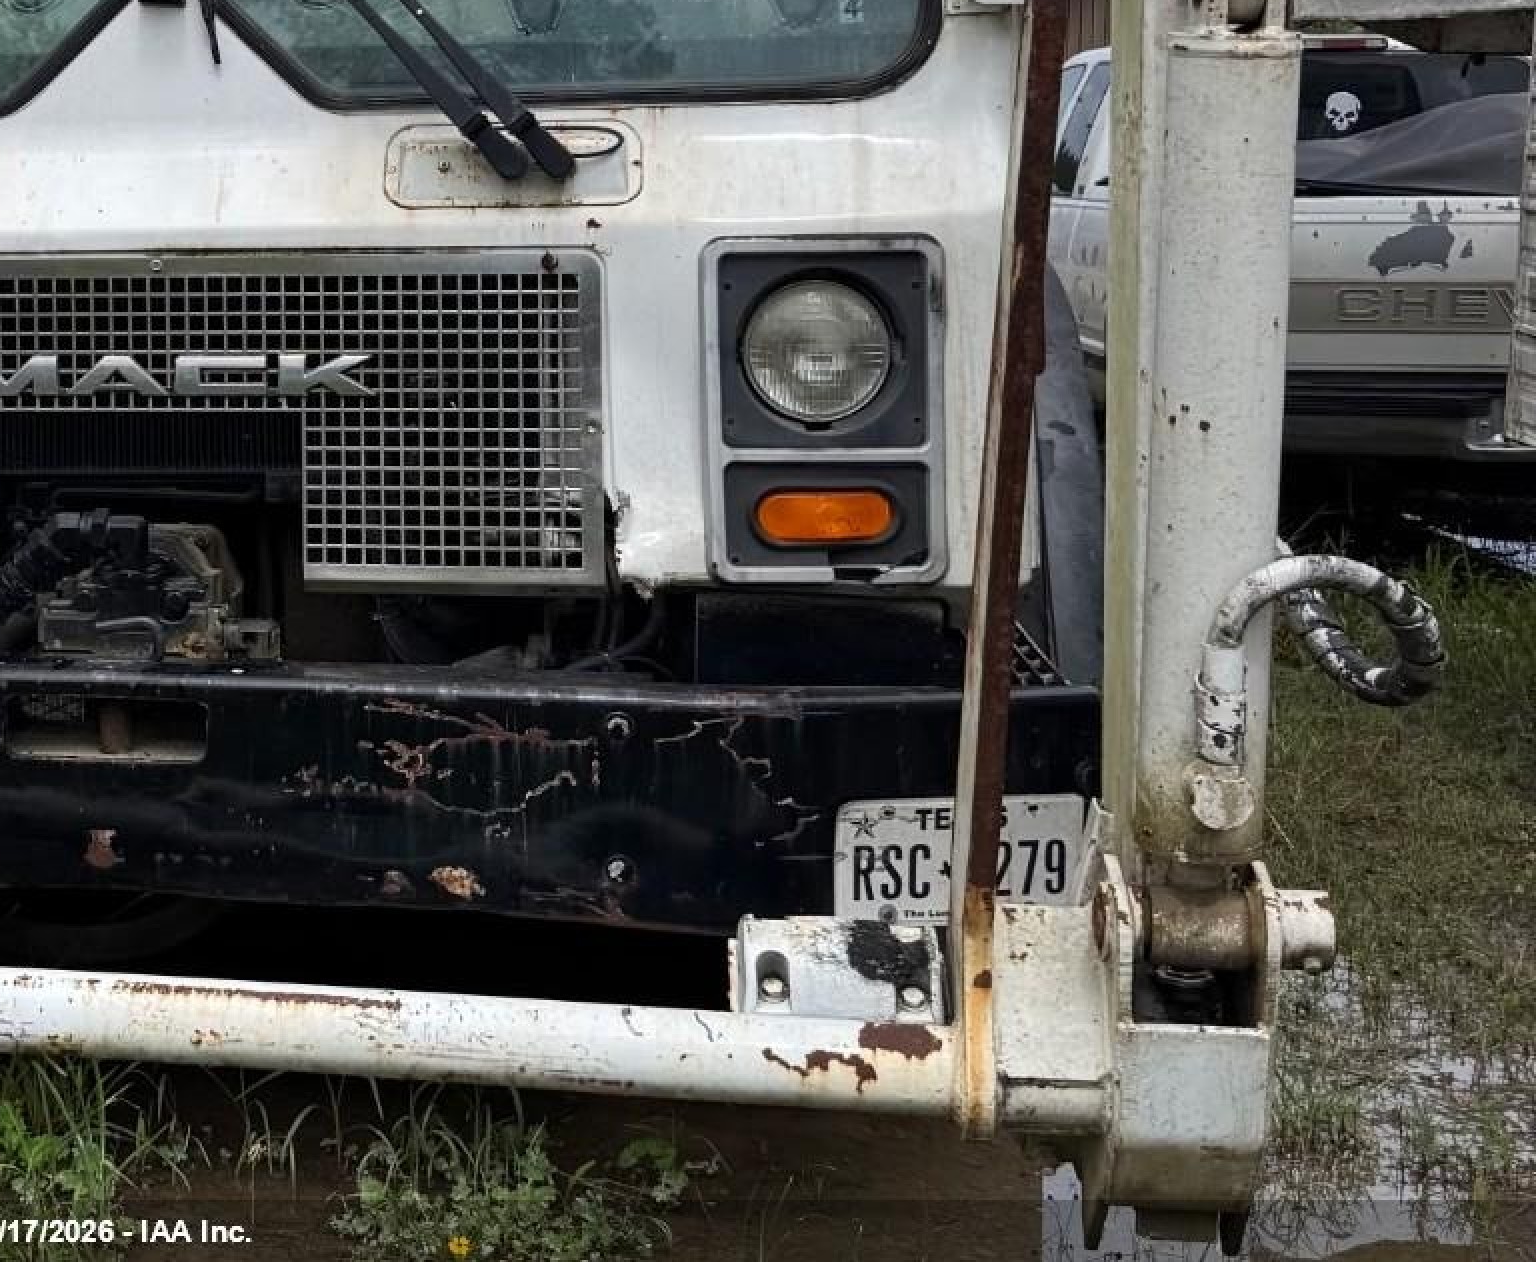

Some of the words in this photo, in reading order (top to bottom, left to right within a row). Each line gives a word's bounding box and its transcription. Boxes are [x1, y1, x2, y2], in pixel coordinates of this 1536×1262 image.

[915, 806, 1008, 831] TES
[853, 843, 931, 901] RSC
[995, 839, 1067, 897] 279
